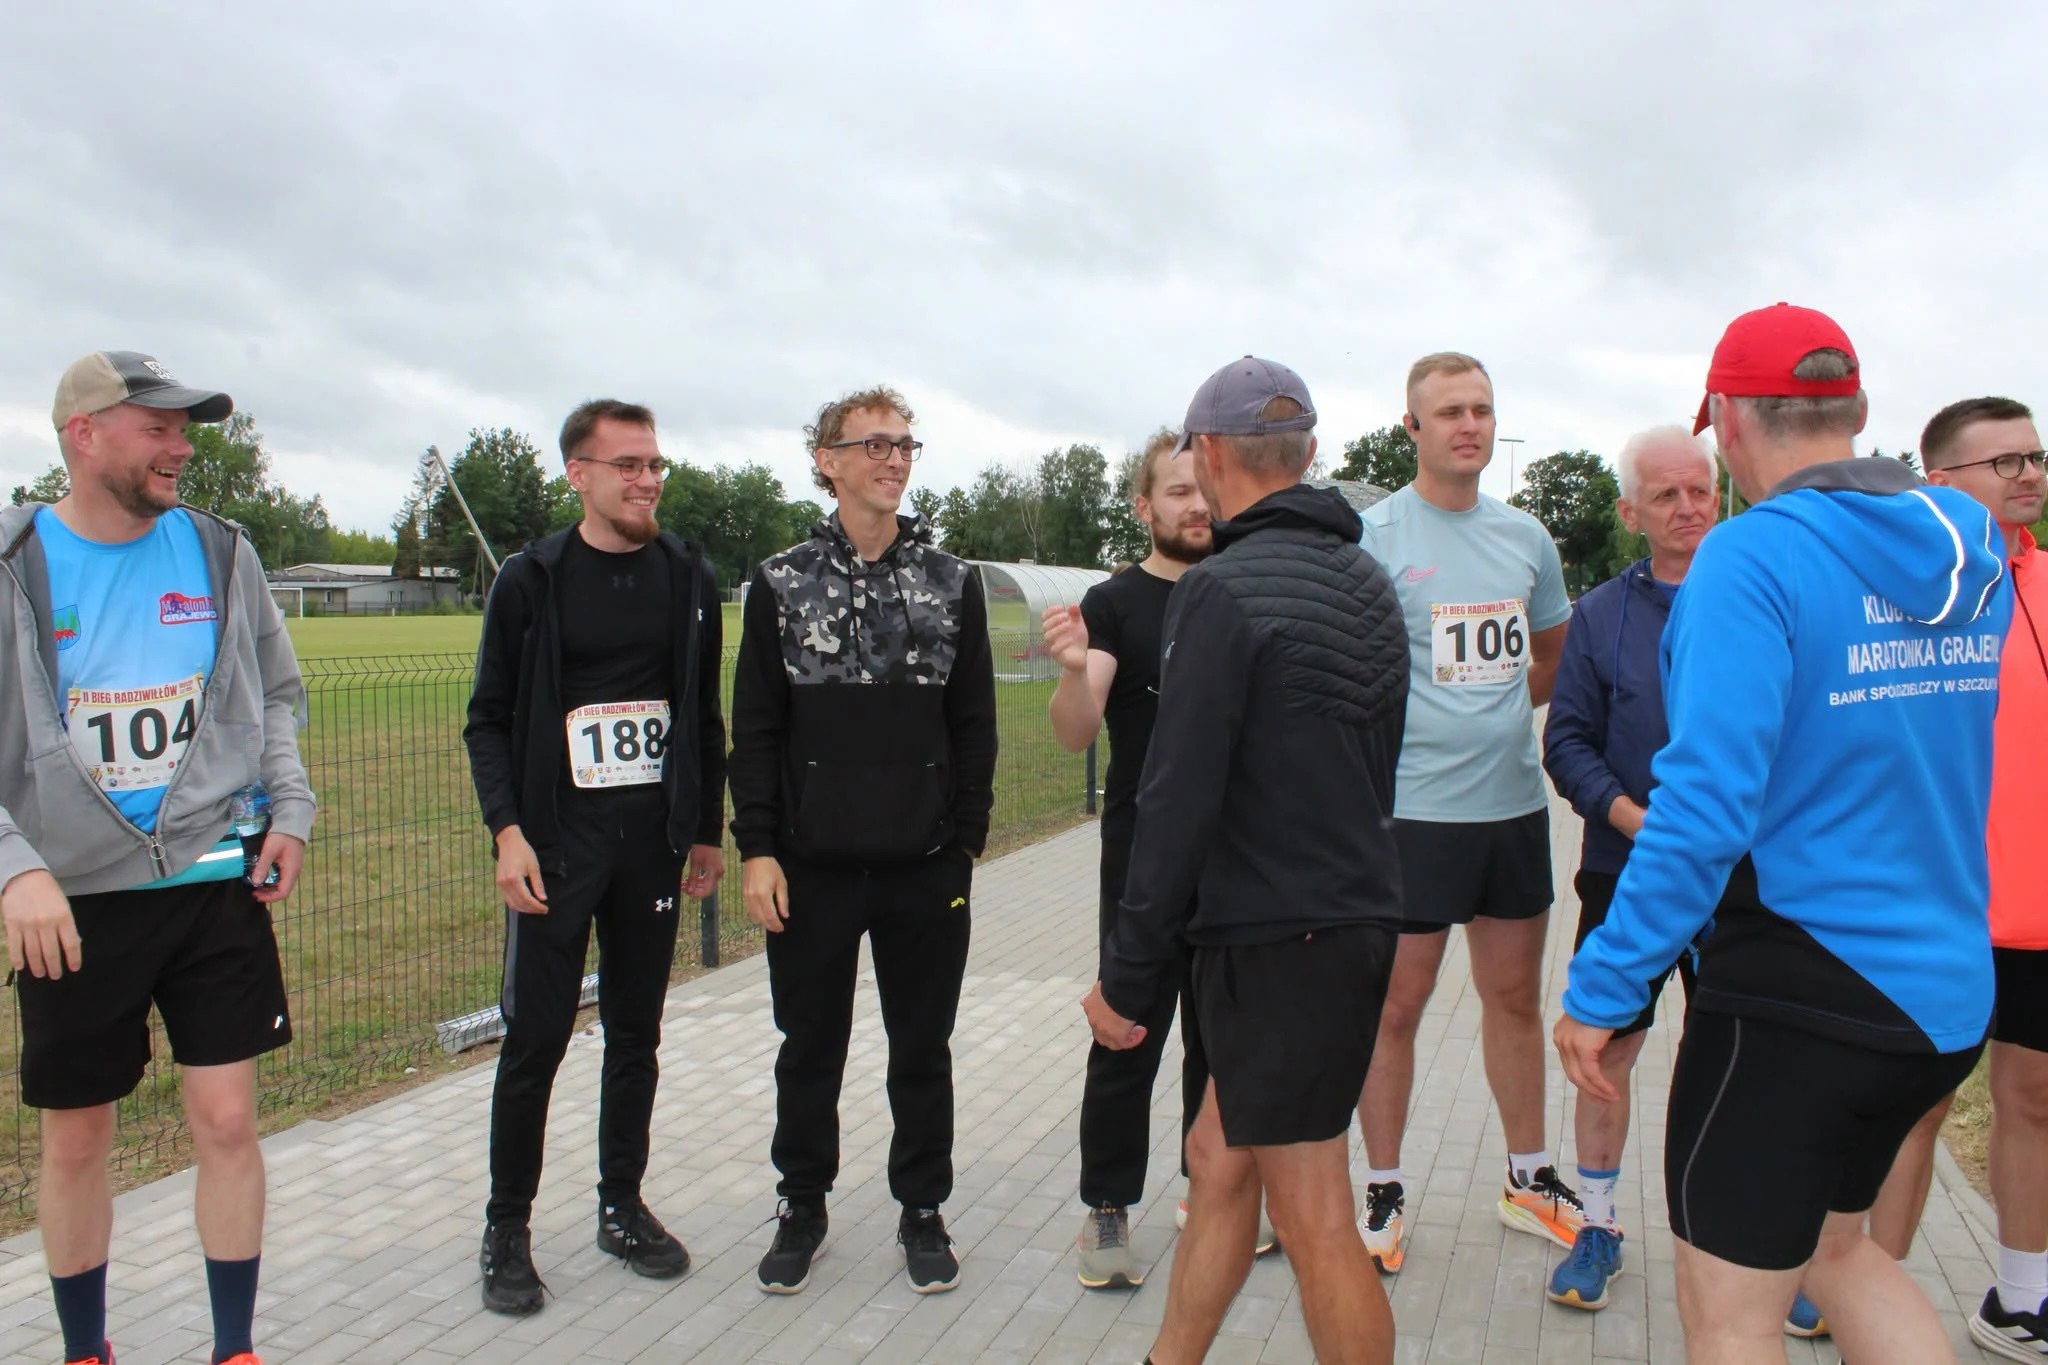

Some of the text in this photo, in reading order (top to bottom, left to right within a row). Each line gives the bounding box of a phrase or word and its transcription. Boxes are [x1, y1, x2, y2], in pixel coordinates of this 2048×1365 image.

[1443, 606, 1447, 614] II
[1449, 605, 1466, 615] BIEG
[1445, 615, 1524, 663] 106
[1847, 638, 1936, 675] MARATONKA
[83, 691, 89, 703] II
[92, 690, 112, 704] BIEG
[114, 684, 178, 704] RADZIWIŁŁÓW
[1829, 688, 1867, 706] BANK
[1944, 680, 1956, 693] W
[584, 706, 599, 716] BIEG
[87, 698, 196, 763] 104
[581, 717, 665, 764] 188
